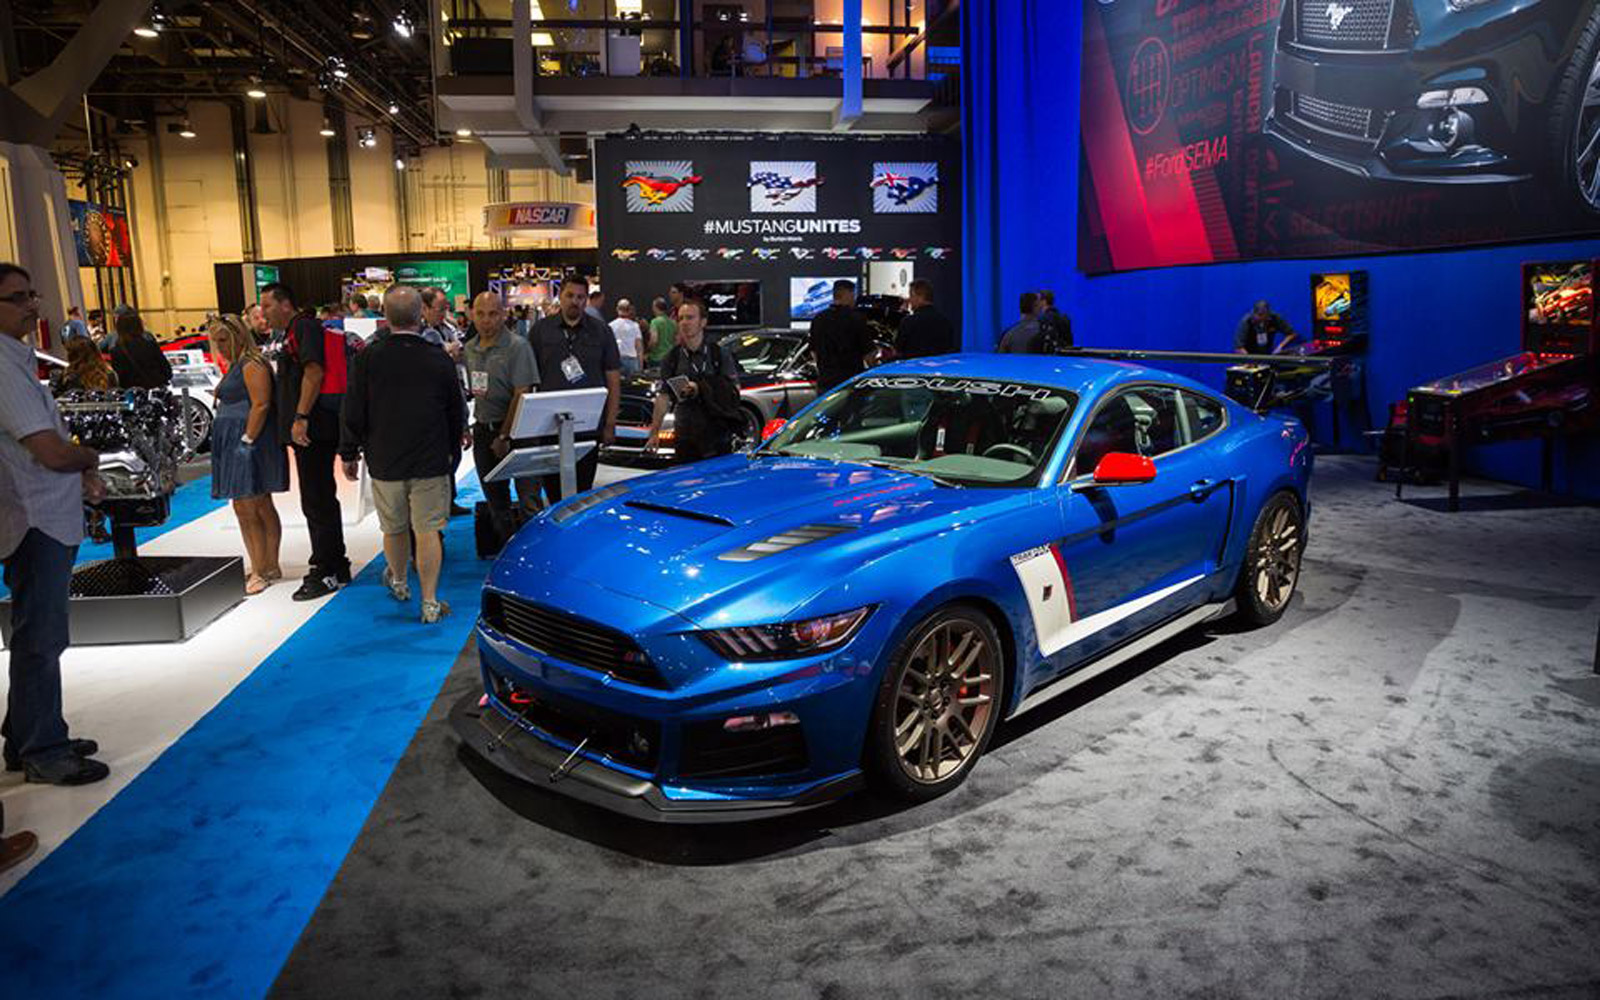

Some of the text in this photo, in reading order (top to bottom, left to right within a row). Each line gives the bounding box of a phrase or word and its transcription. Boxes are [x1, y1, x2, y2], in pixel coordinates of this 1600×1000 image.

[514, 207, 567, 225] NASCAR
[703, 219, 861, 235] #MUSTANGUNITES
[854, 377, 1051, 401] ROUSH
